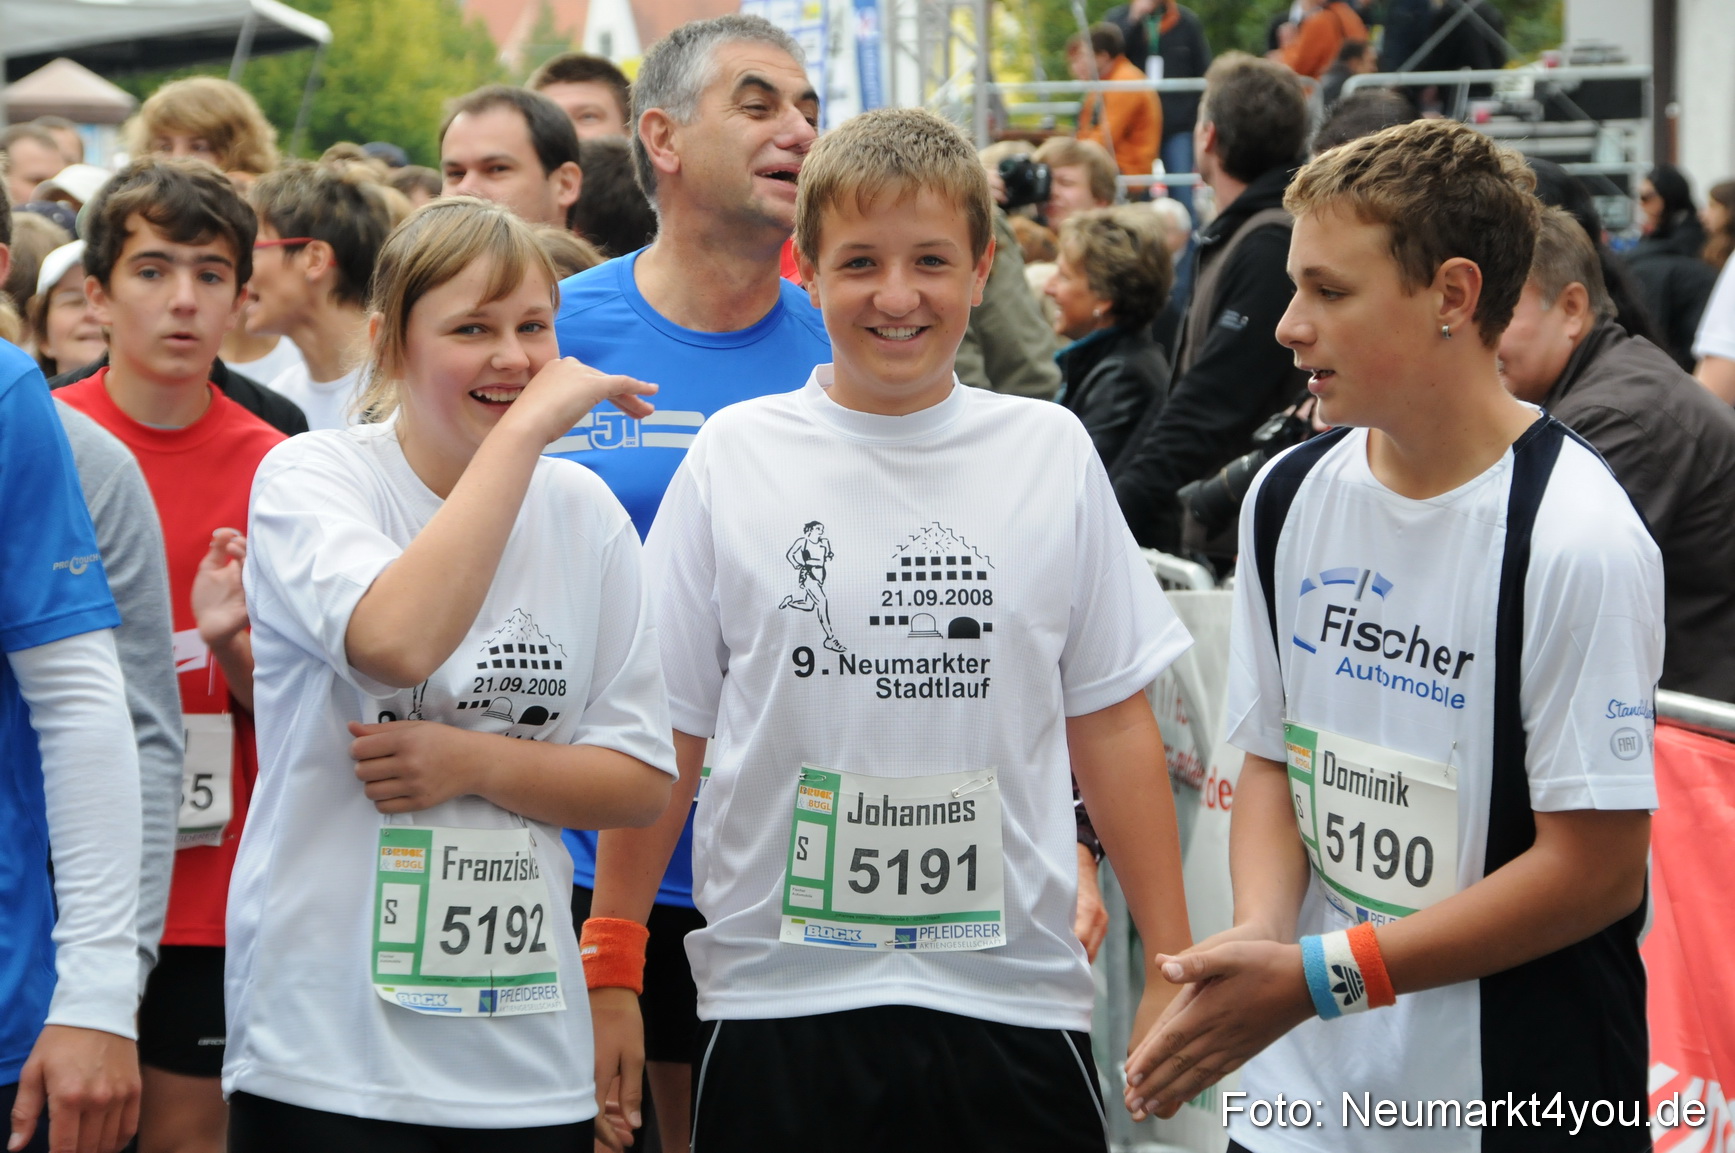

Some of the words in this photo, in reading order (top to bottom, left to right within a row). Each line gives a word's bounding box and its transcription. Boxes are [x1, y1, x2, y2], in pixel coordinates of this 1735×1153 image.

[52, 560, 70, 571] PRO
[880, 588, 993, 607] 21.09.2008
[1319, 603, 1475, 680] Fischer
[791, 645, 830, 678] 9.
[838, 651, 991, 676] Neumarkter
[472, 676, 567, 697] 21.09.2008
[875, 676, 991, 700] Stadtlauf
[1335, 656, 1466, 710] Automobile
[1617, 736, 1636, 753] FIAT
[1322, 750, 1410, 808] Dominik
[799, 785, 833, 801] DRUCK
[808, 799, 832, 811] BÜGL
[846, 791, 976, 827] Johannes
[1295, 793, 1305, 820] S
[796, 835, 809, 861] S
[1326, 811, 1434, 889] 5190
[394, 859, 424, 870] BÜGL
[441, 845, 540, 882] Franziska
[847, 844, 978, 896] 5191
[384, 898, 398, 925] S
[439, 903, 547, 956] 5192
[804, 925, 862, 942] BOCK
[918, 923, 1001, 940] PFLEIDERER
[918, 939, 1002, 950] AKTIENGESELLSCHAFT
[396, 992, 449, 1007] BOCK
[500, 985, 560, 1004] PFLEIDERER
